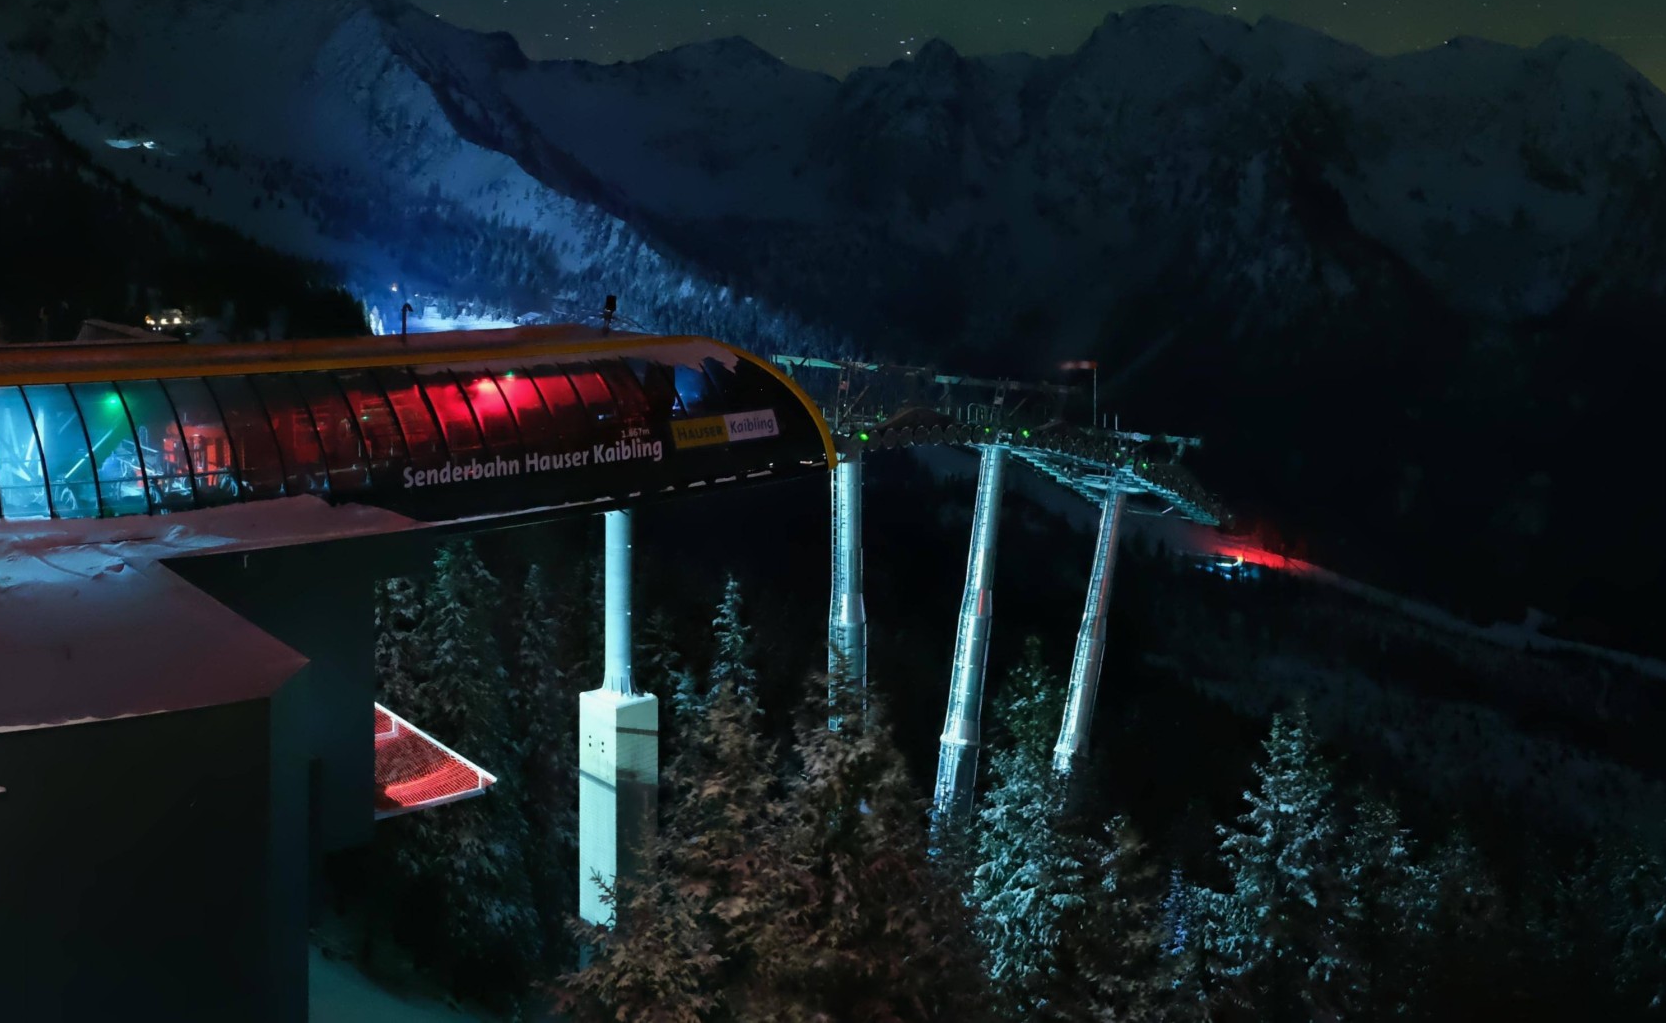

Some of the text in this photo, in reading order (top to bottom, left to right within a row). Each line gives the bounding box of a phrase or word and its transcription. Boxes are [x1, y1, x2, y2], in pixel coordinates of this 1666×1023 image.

[676, 417, 774, 442] HAUSER Kaibling
[403, 438, 663, 488] Senderbahn Hauser Kaibling
